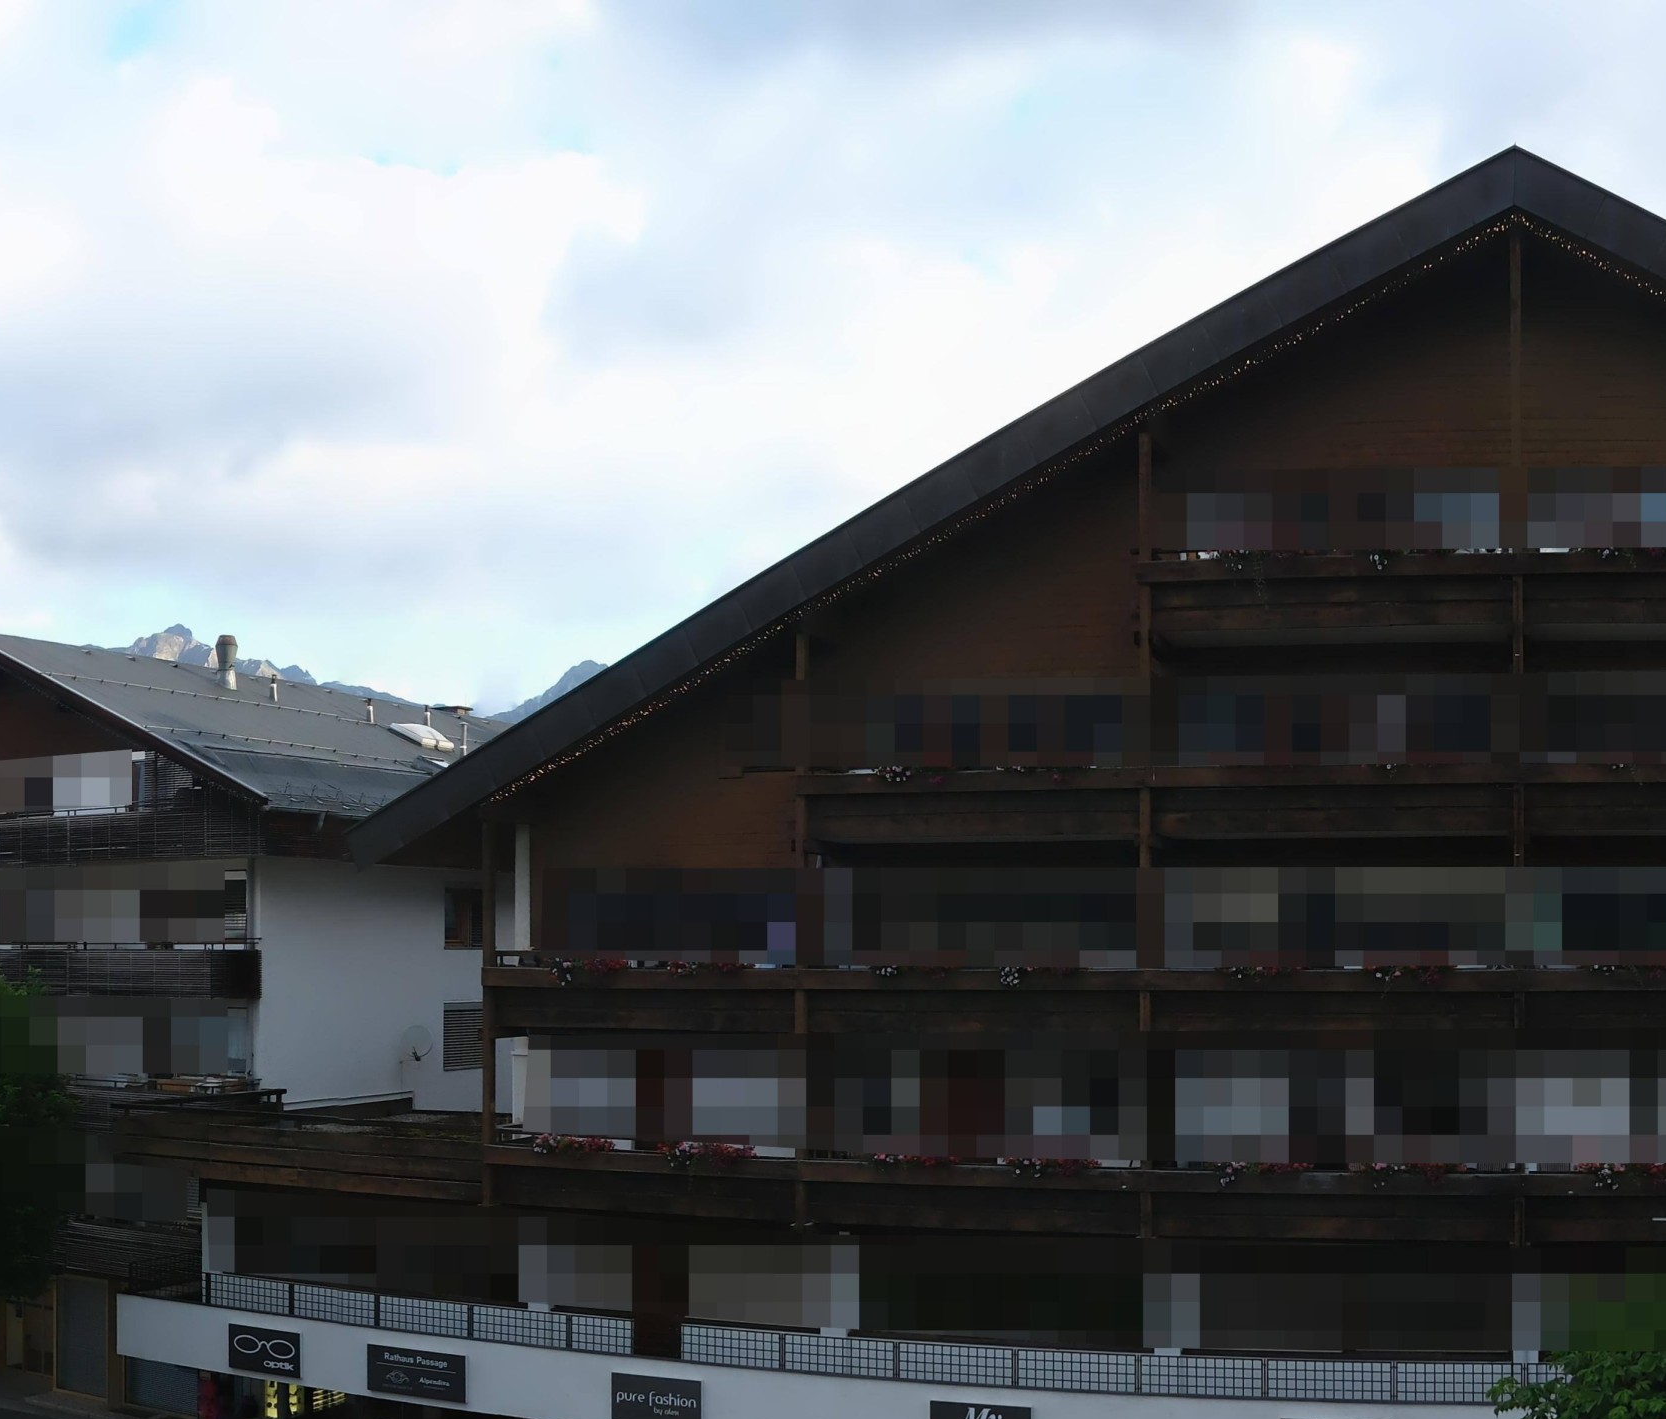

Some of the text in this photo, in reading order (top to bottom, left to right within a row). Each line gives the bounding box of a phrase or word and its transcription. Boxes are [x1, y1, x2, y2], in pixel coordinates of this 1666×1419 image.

[263, 1359, 295, 1372] optik
[384, 1351, 448, 1369] Rathaus Passage
[616, 1390, 697, 1409] pure fashion
